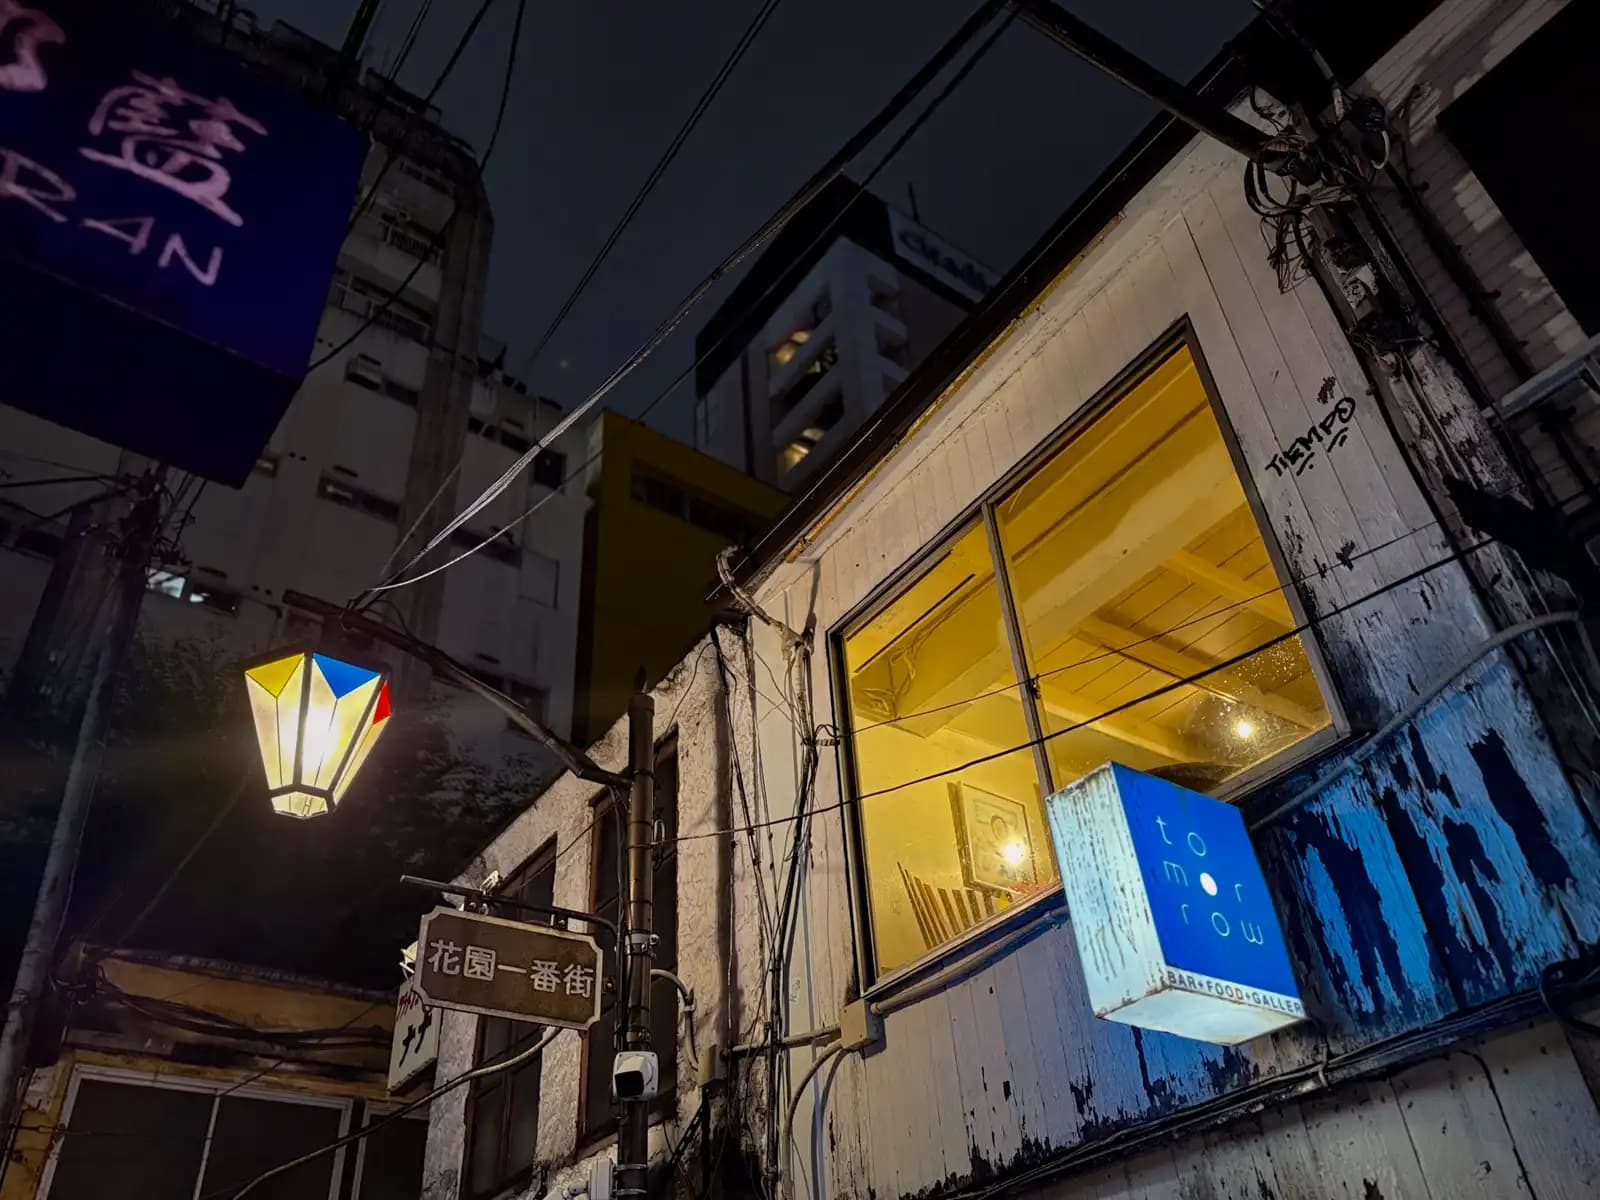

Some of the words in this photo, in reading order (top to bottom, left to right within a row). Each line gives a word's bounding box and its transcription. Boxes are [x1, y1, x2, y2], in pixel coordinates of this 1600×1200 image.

[427, 939, 595, 998] 花園一番街
